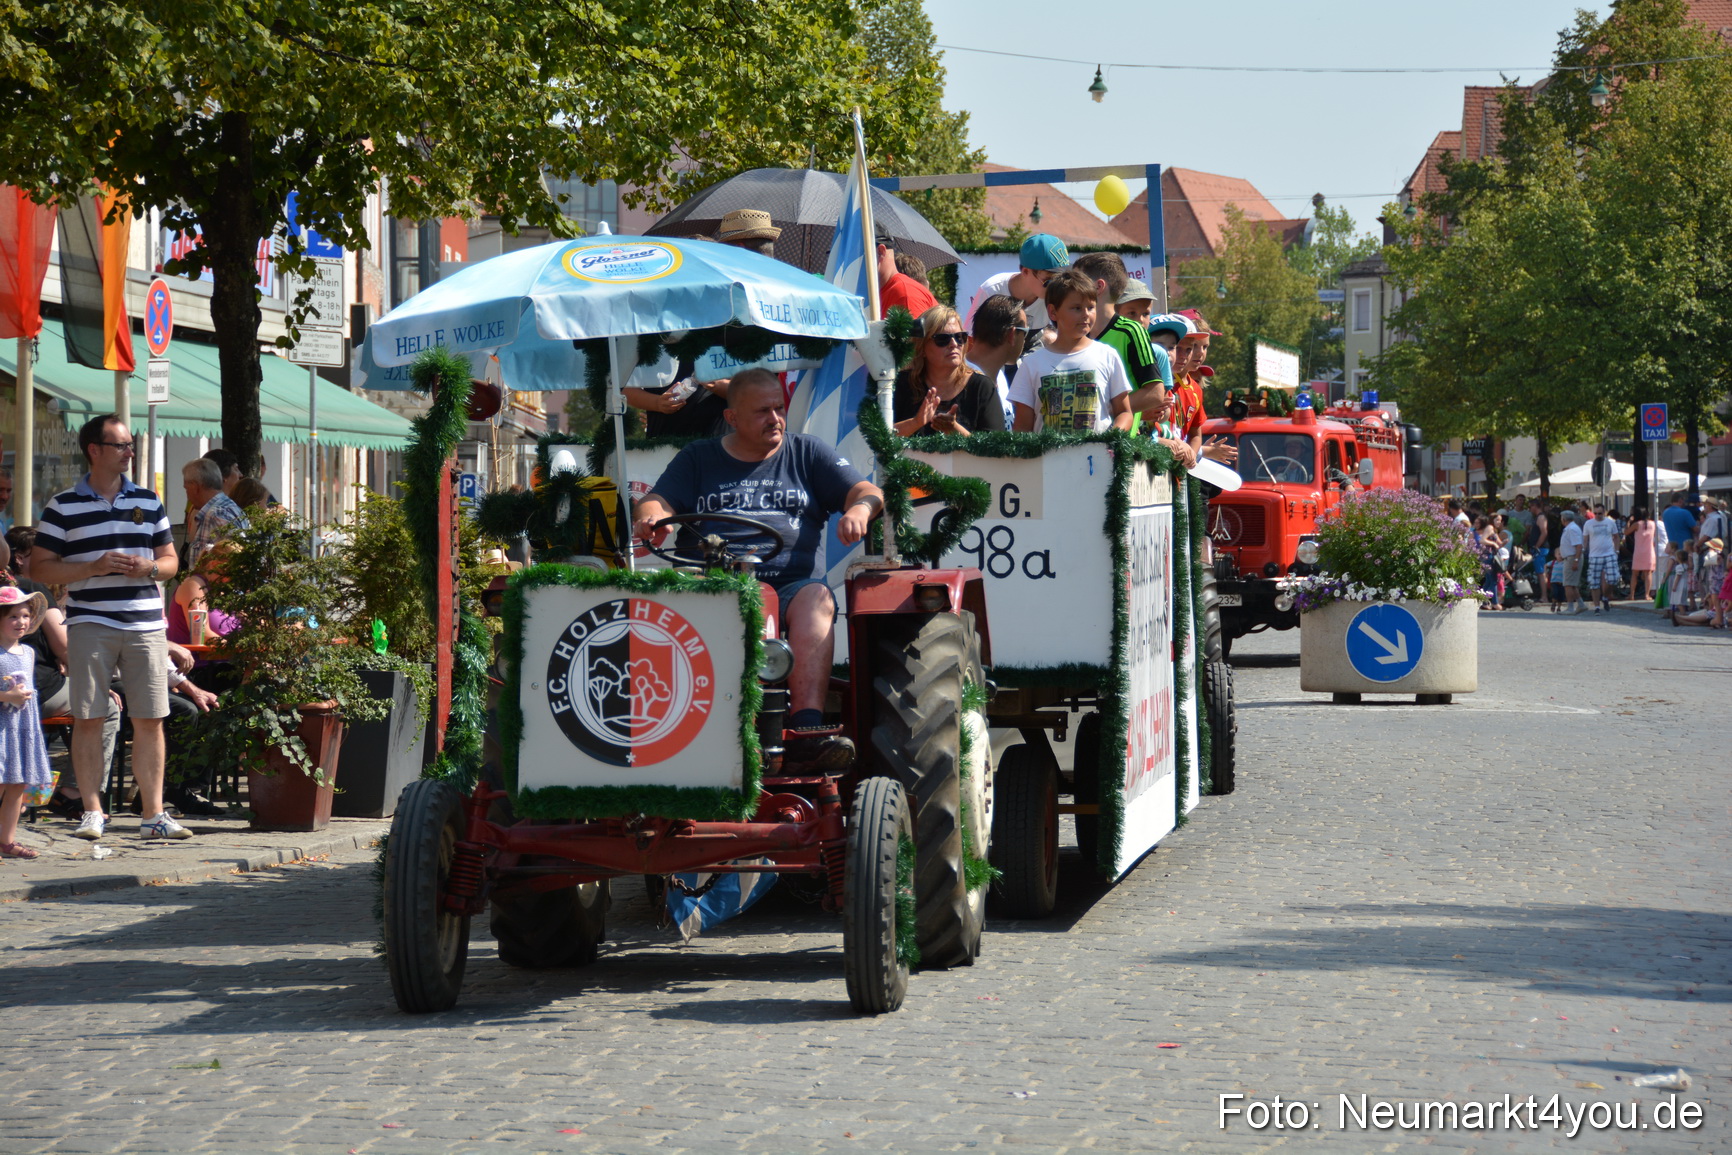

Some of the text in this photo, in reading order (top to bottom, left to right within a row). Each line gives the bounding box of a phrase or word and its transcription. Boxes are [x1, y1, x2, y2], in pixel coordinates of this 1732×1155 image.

[581, 249, 657, 268] Glossner
[756, 300, 842, 328] HELLE WOLKE
[453, 320, 505, 344] WOLKE
[1644, 429, 1665, 437] TAXI
[1464, 440, 1485, 448] MATT
[462, 477, 474, 494] P
[718, 481, 737, 490] BOAT
[696, 489, 810, 514] OCEAN CREW
[549, 600, 710, 715] F.C. HOLZHEIM e.V.
